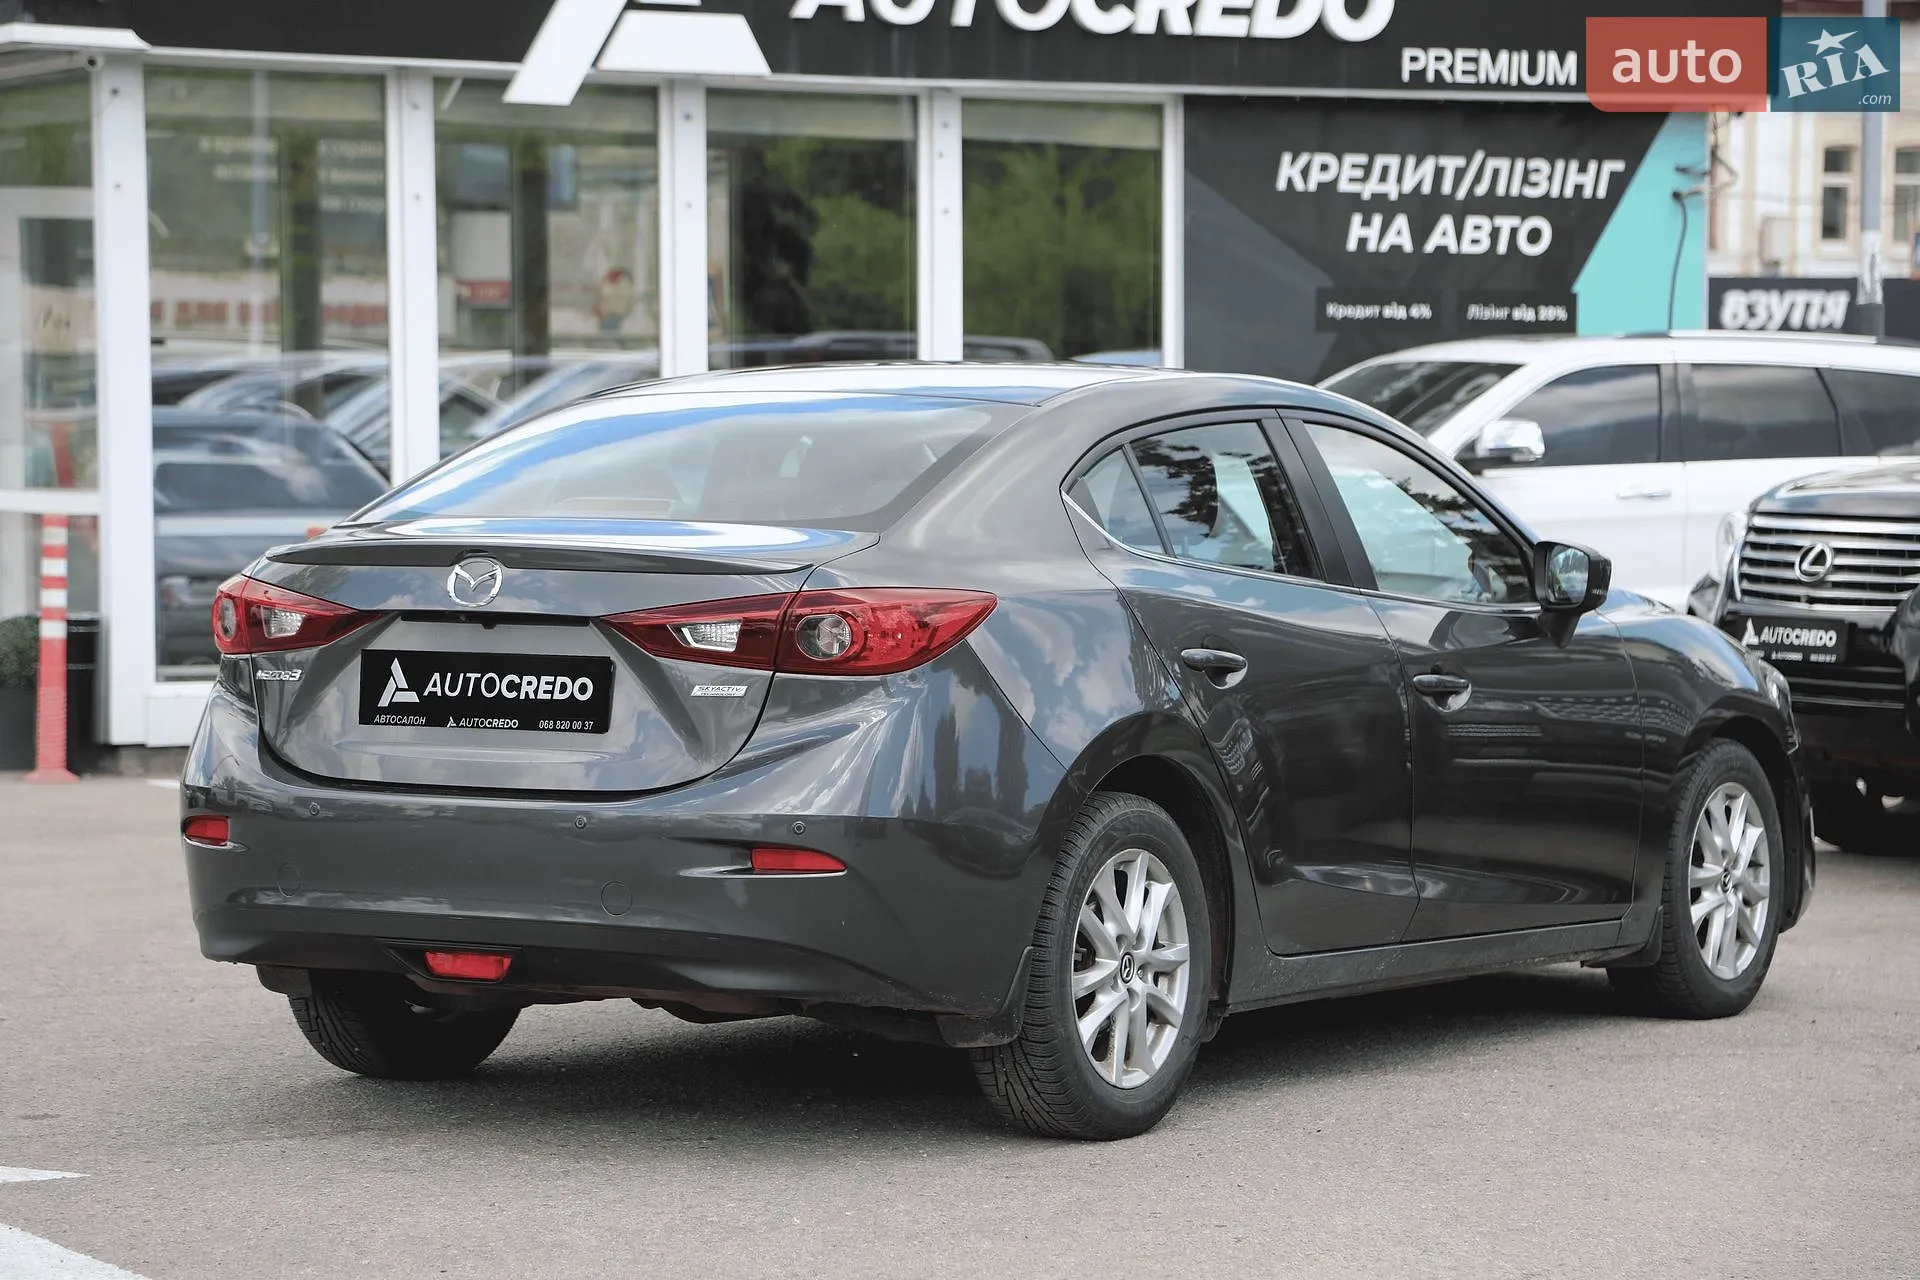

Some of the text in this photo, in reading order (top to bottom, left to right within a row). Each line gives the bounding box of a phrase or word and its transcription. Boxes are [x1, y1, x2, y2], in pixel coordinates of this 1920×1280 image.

[1401, 47, 1578, 86] PREMIUM
[1276, 149, 1626, 200] КРЕДИТ/ЛІЗІНГ
[1345, 212, 1553, 256] НА АВТО
[1326, 302, 1381, 320] Кредит
[1382, 301, 1407, 320] від
[1466, 303, 1510, 320] Лізінг
[1760, 626, 1837, 648] AUTOCREDO
[423, 672, 594, 701] AUTOCREDO
[373, 714, 426, 725] АВТОСАЛОН
[459, 718, 519, 729] AUTOCREDO
[538, 720, 594, 731] 068 820 00 37
